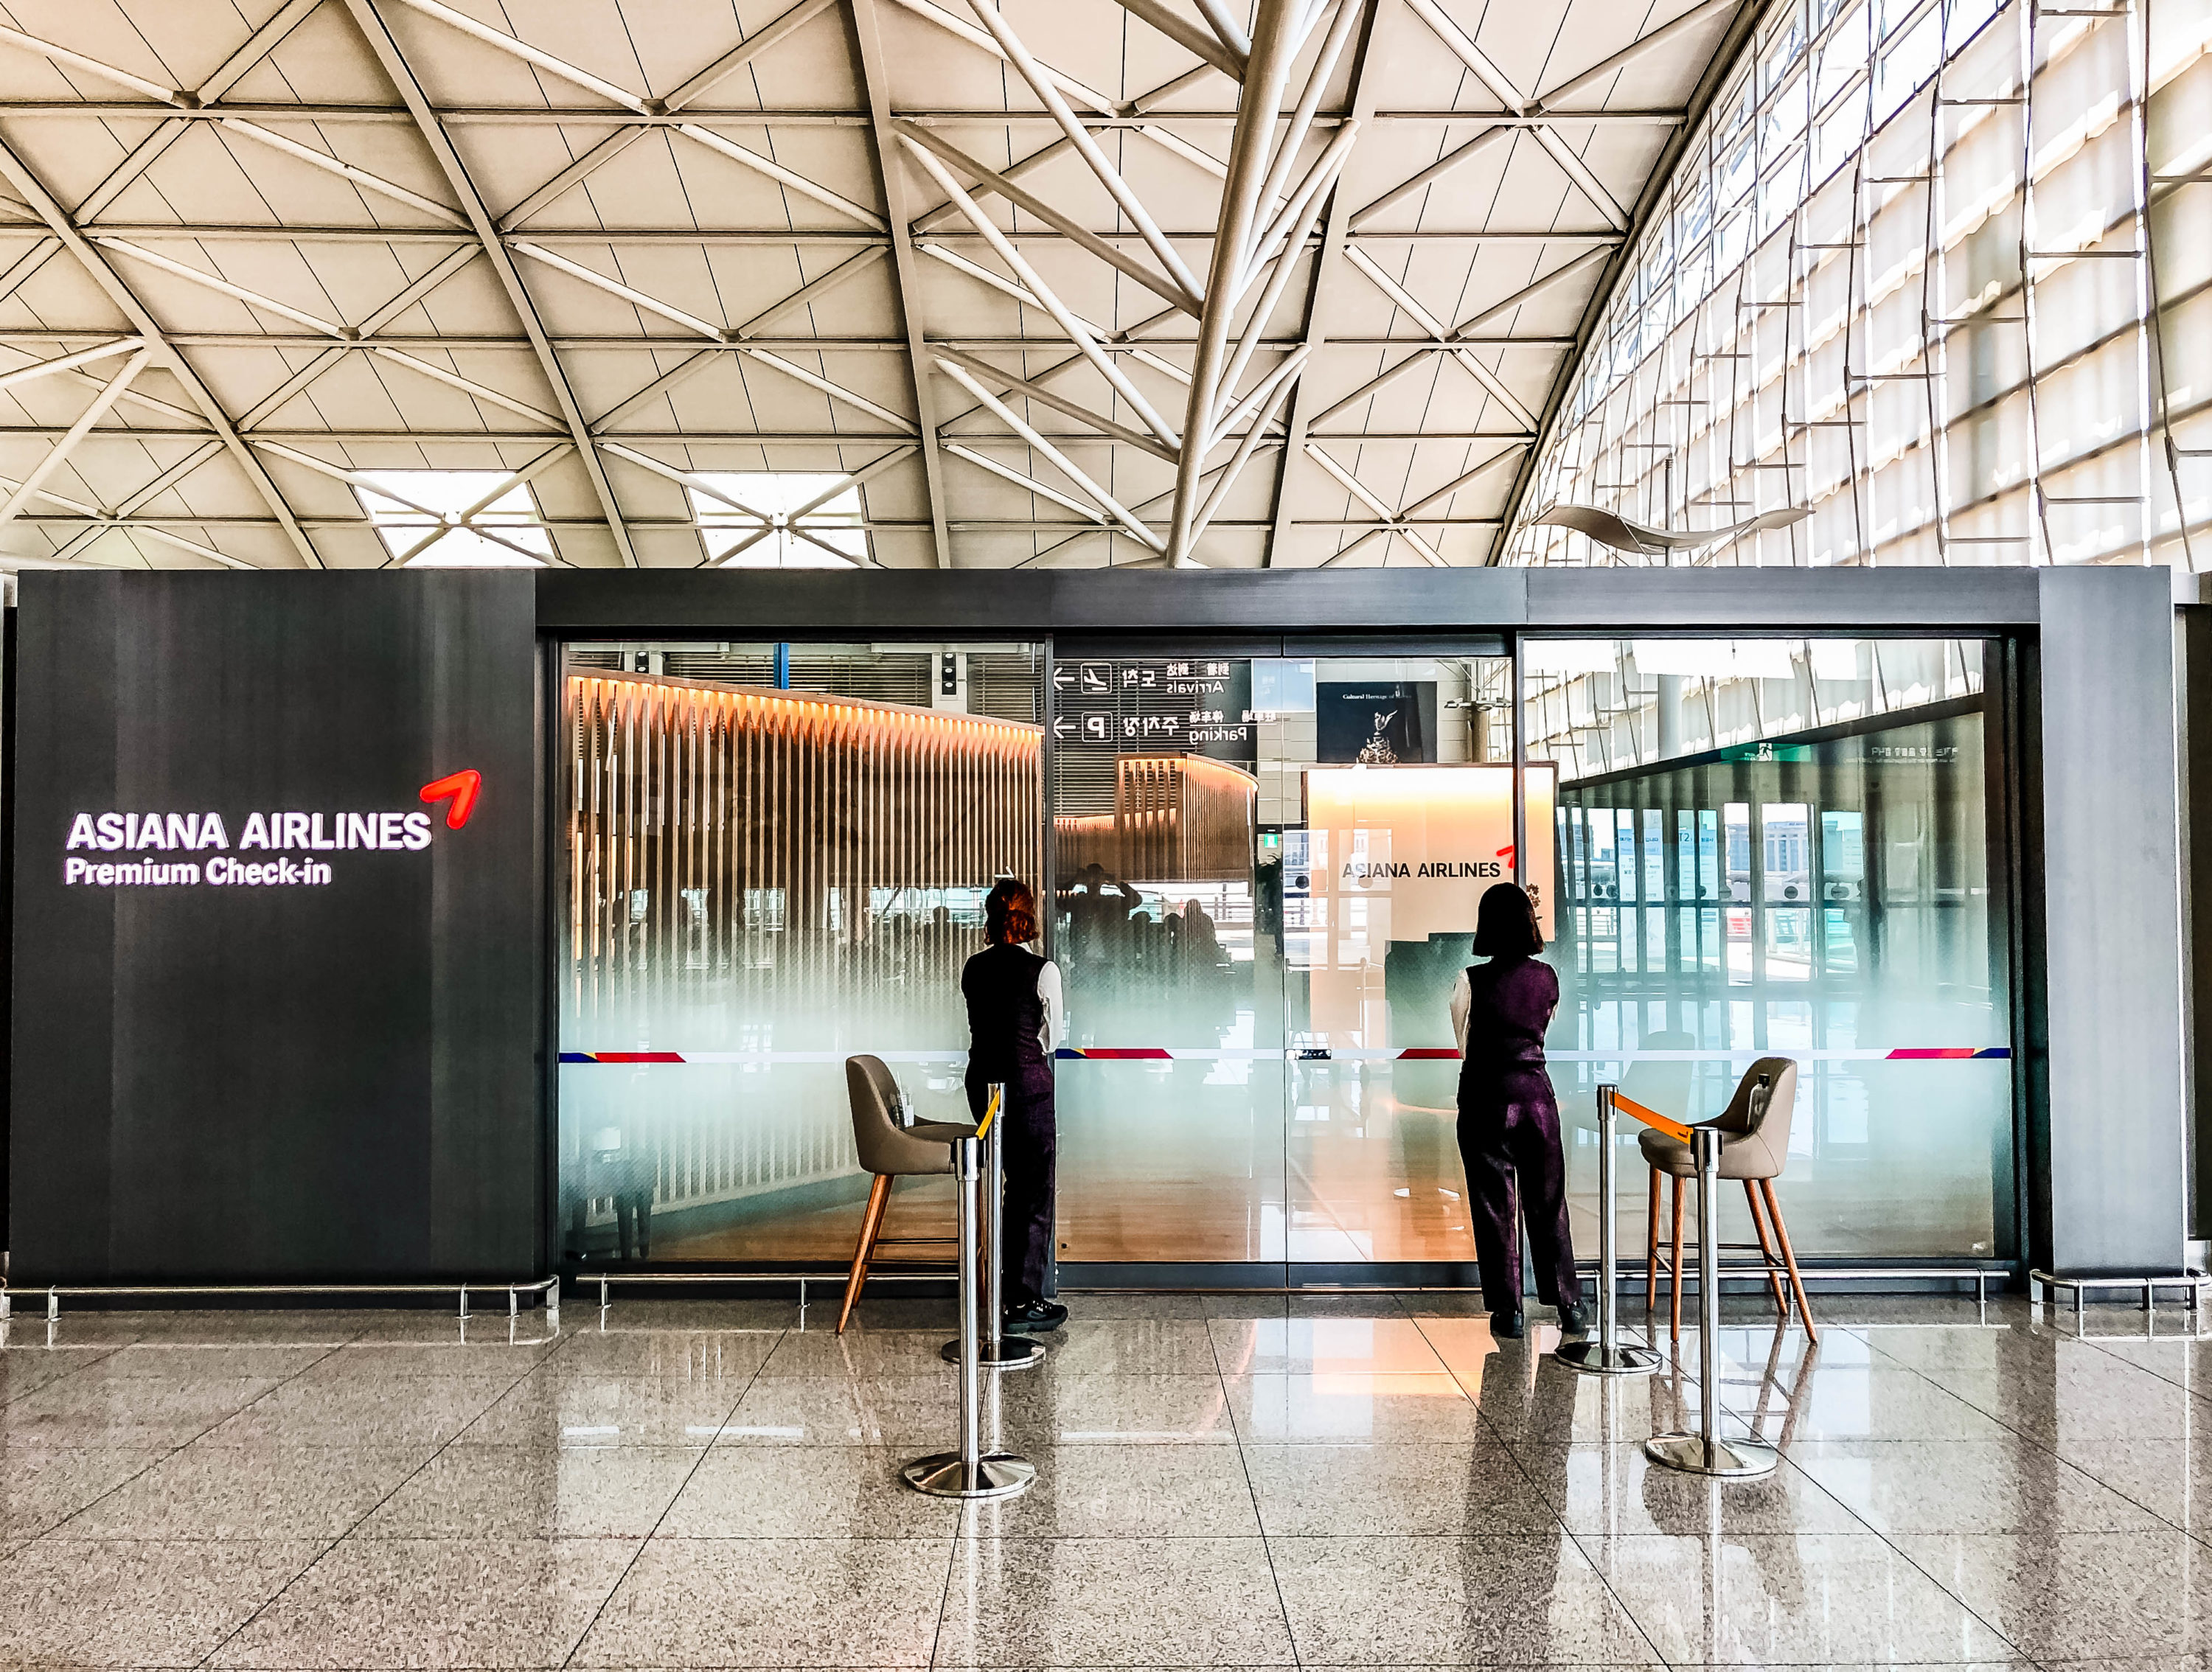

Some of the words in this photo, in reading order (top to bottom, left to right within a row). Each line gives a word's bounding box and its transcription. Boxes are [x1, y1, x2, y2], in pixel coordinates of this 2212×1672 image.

[66, 812, 229, 850] ASIANA
[239, 812, 432, 850] AIRLINES
[65, 857, 200, 885] Premium
[205, 857, 332, 885] Check-in
[1342, 862, 1411, 878] ASIANA
[1417, 862, 1500, 878] AIRLINES
